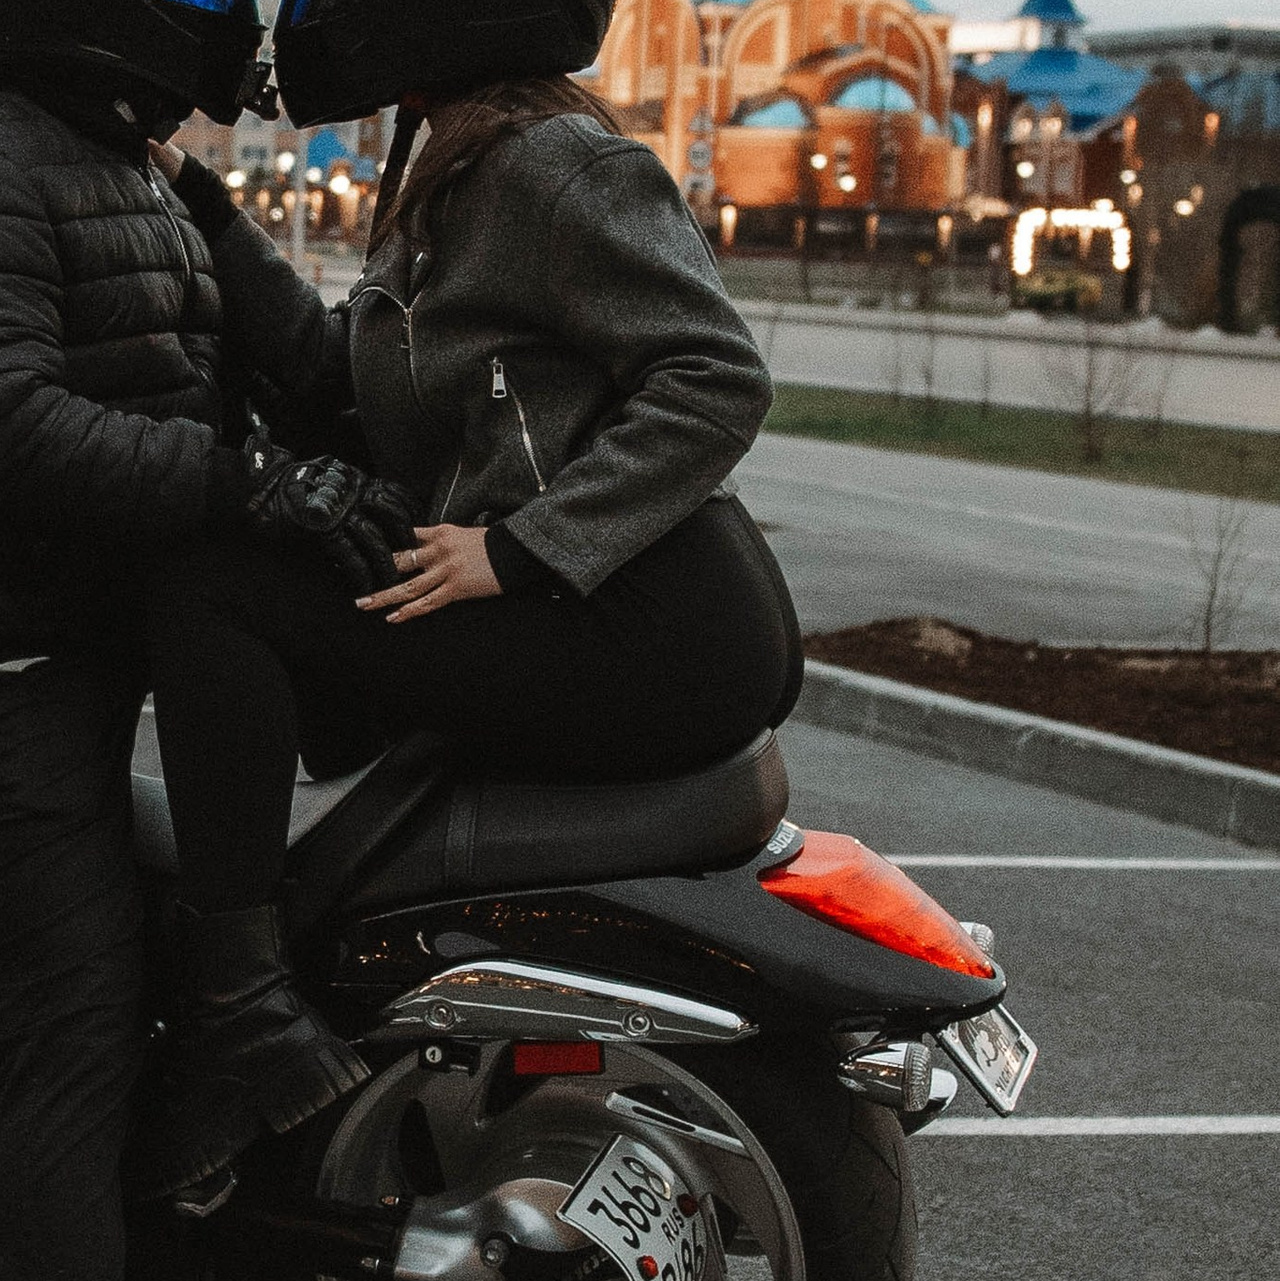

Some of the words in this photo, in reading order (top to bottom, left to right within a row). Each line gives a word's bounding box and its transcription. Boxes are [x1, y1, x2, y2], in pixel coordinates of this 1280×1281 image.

[767, 825, 795, 854] SUZU
[587, 1157, 672, 1249] 3668
[660, 1209, 685, 1245] RUS
